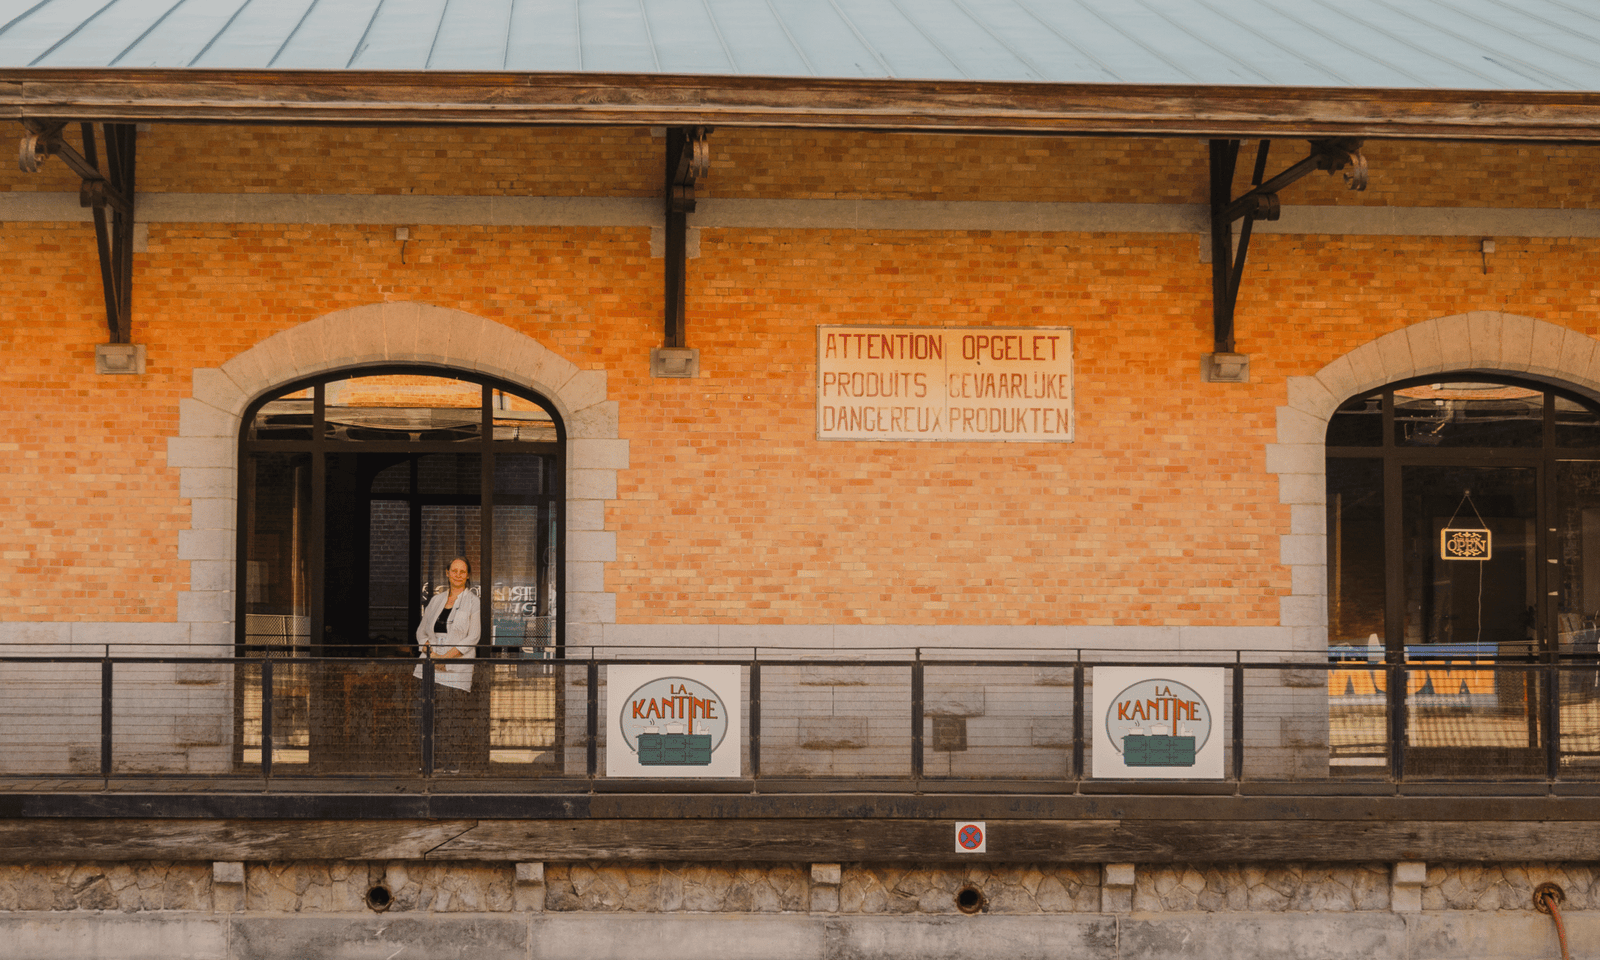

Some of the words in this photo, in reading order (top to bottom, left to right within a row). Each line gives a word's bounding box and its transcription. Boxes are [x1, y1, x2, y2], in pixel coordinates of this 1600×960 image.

[825, 332, 943, 360] ATTENTION
[962, 335, 1060, 361] OPGELET
[823, 370, 927, 398] PRODUITS
[823, 405, 943, 432] DANGEREUX
[949, 407, 1069, 434] PRODUKTEN
[1447, 540, 1487, 552] OPEN
[671, 684, 687, 694] LA
[1155, 686, 1172, 696] LA
[632, 692, 718, 735] KANTINE
[1118, 694, 1202, 736] KANTINE
